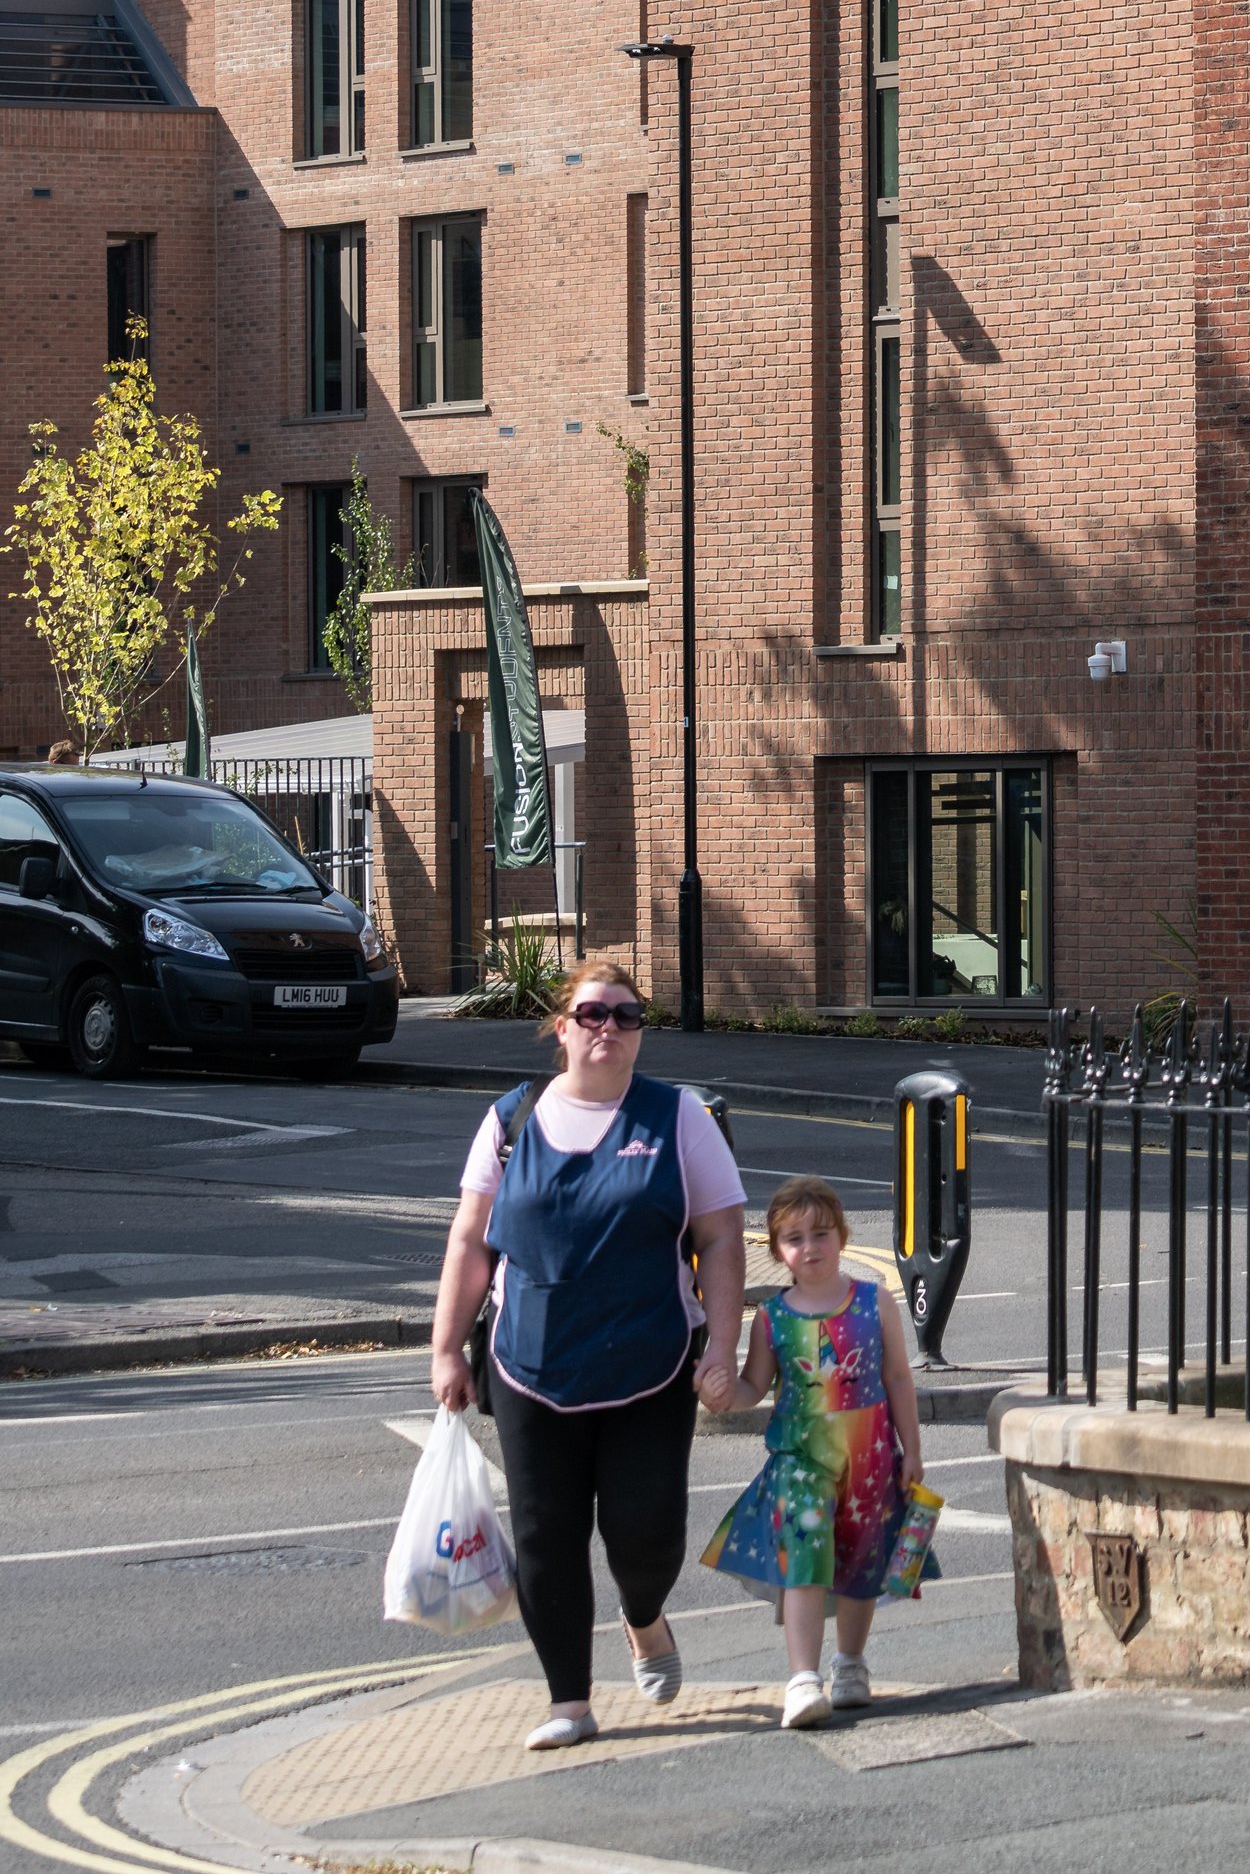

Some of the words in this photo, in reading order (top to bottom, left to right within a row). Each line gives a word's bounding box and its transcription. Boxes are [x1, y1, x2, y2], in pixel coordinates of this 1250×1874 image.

[511, 742, 530, 854] FUSION
[282, 988, 311, 1003] LM16
[314, 988, 340, 1003] HUU
